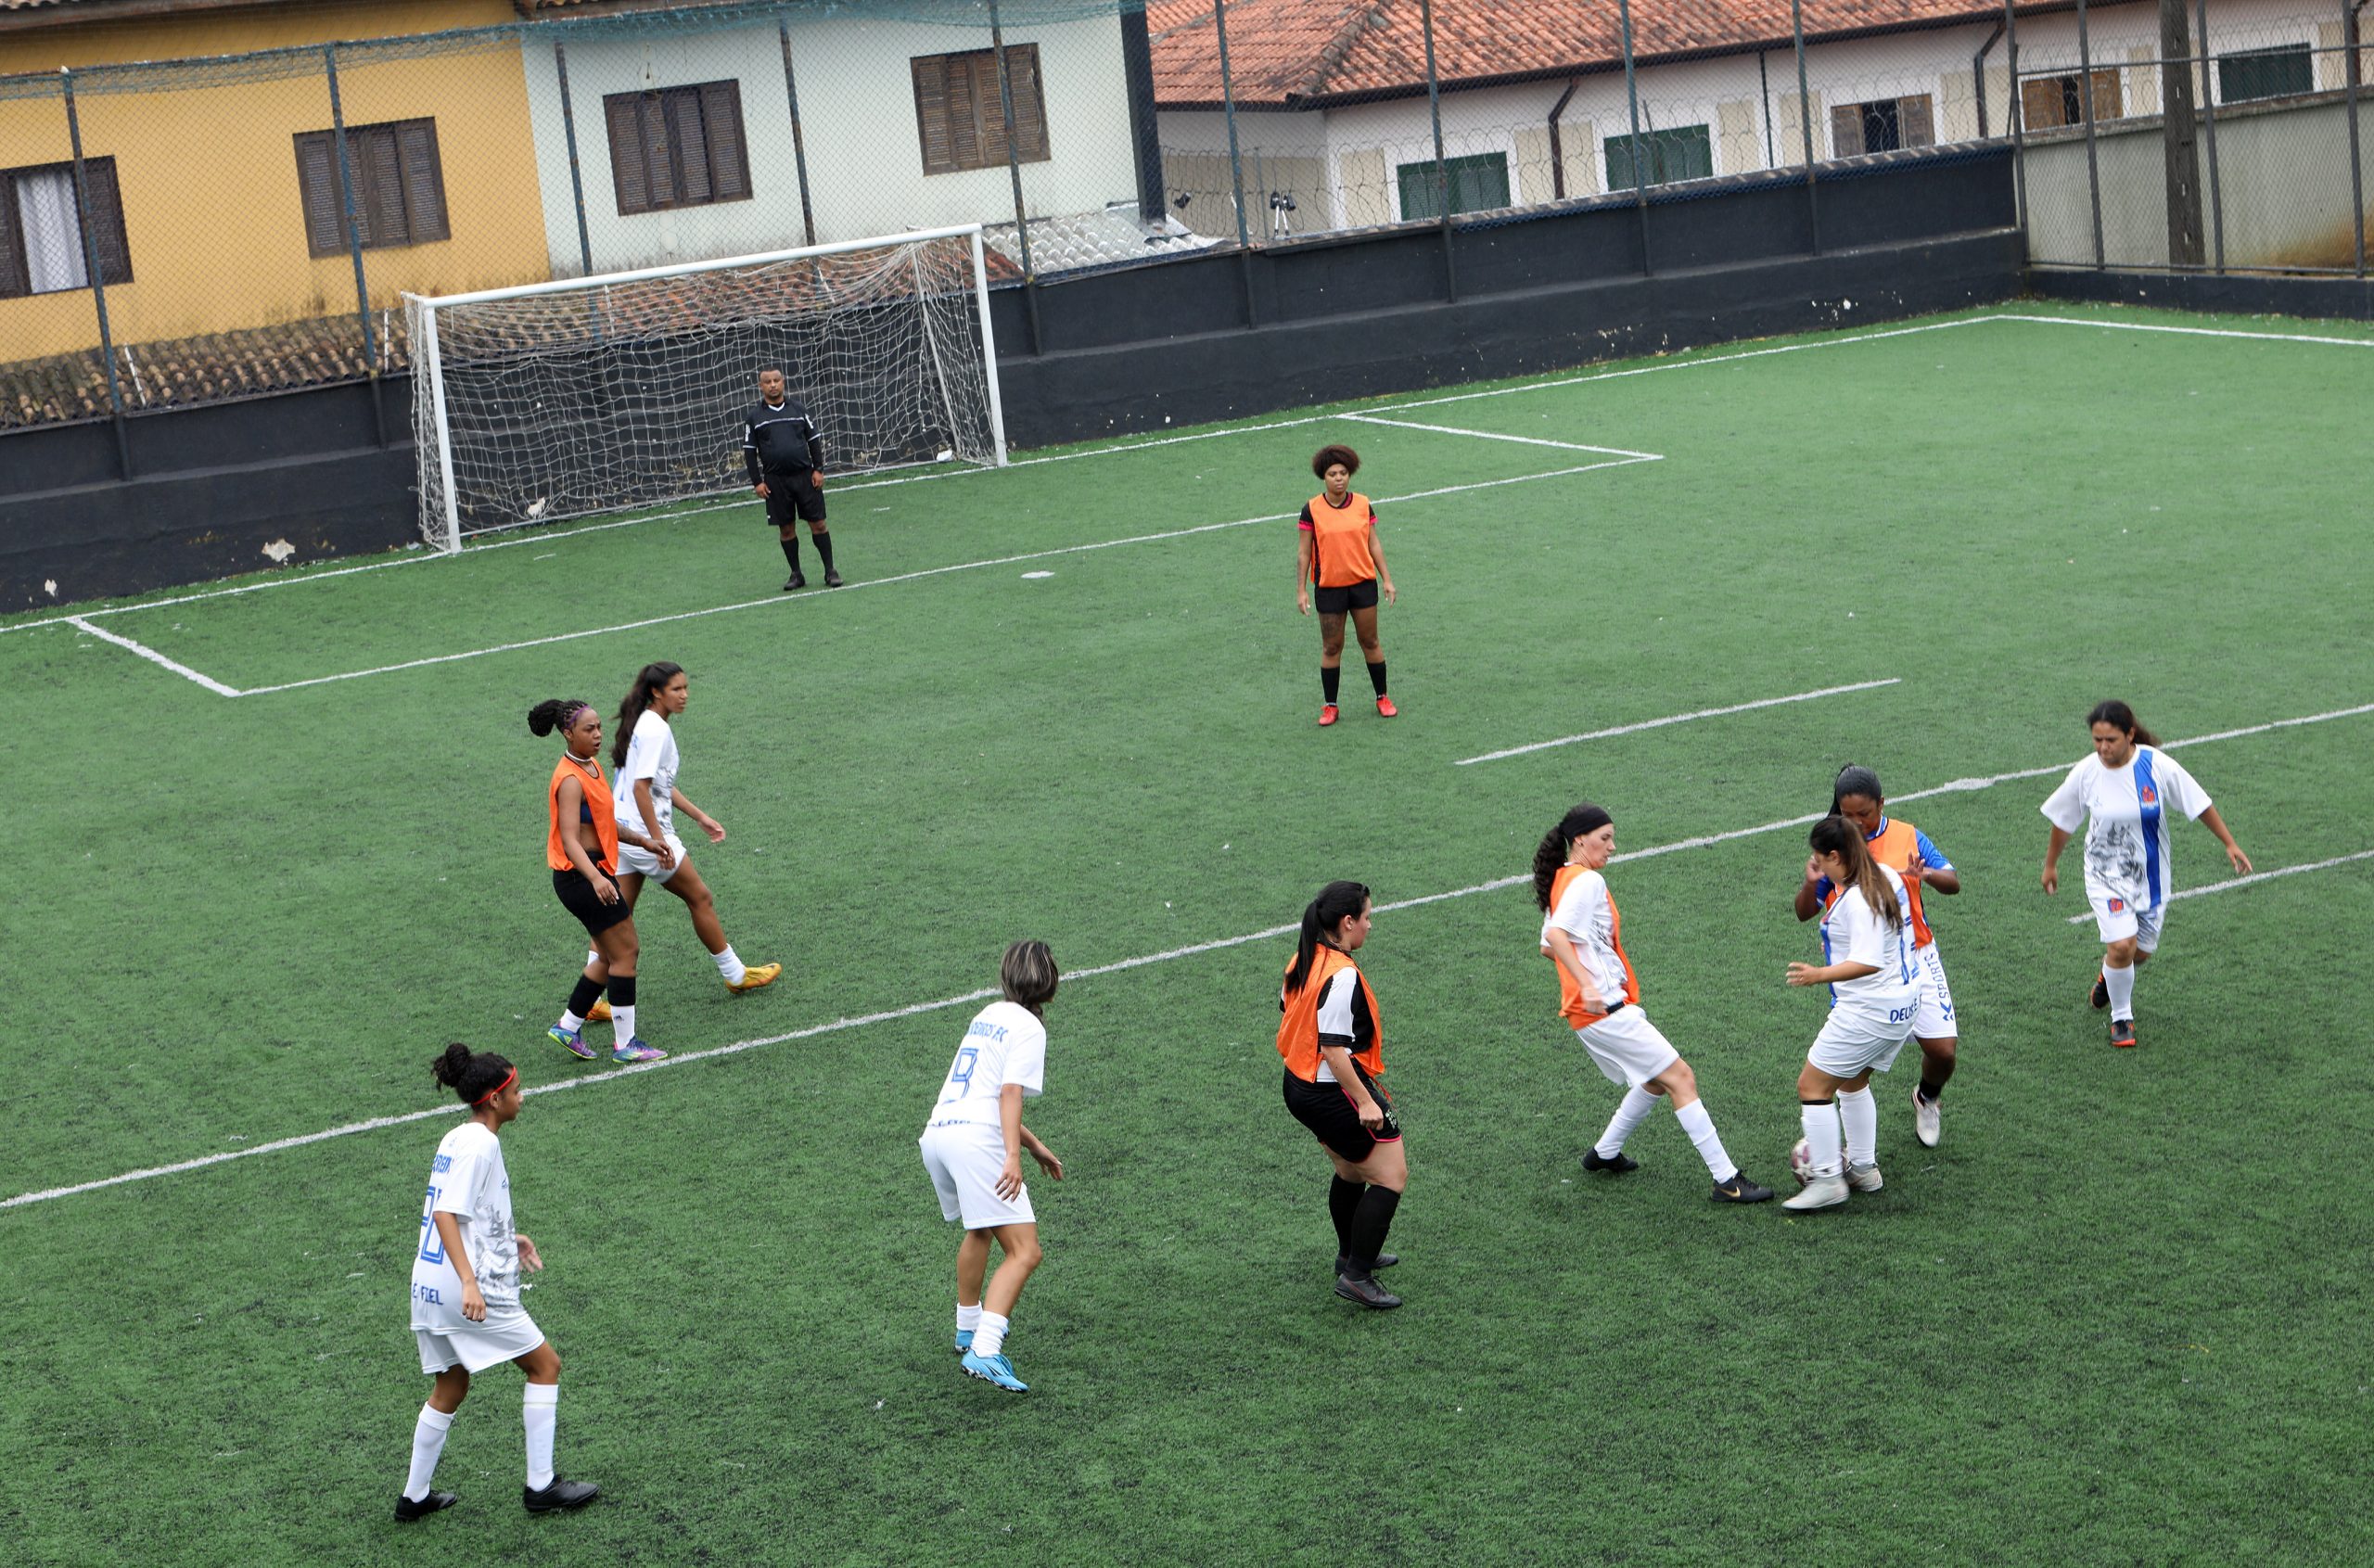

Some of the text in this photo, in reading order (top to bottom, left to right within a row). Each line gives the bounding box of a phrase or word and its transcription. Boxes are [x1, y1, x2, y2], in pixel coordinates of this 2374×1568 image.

[1923, 952, 1950, 999] SPORTS
[942, 1048, 979, 1106] 9
[421, 1285, 444, 1306] FIEL
